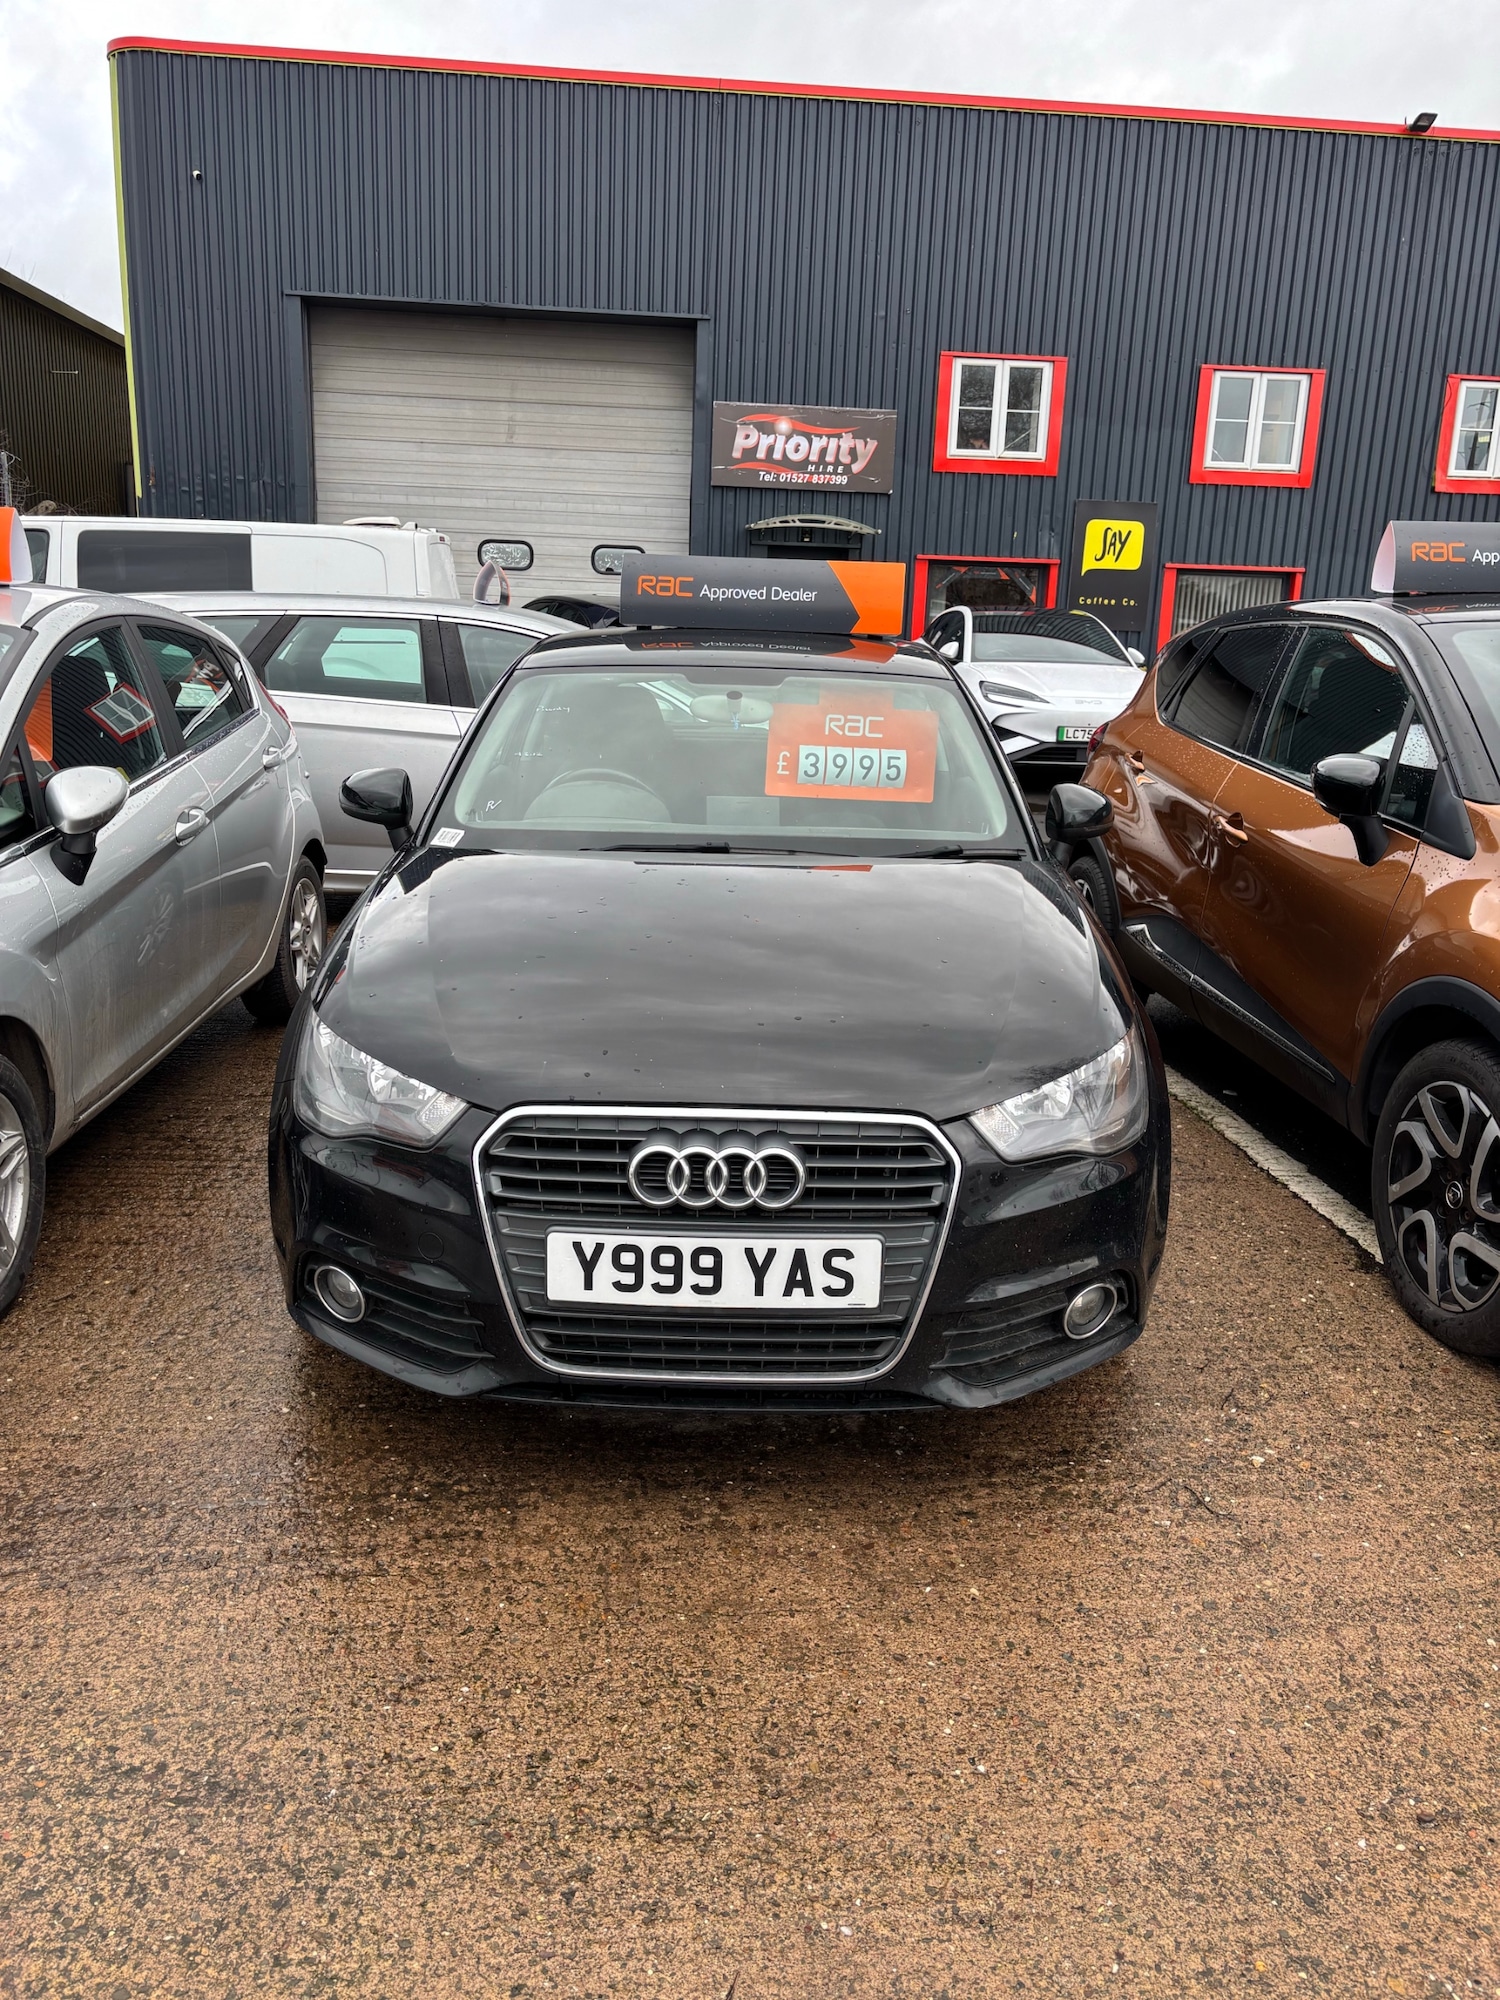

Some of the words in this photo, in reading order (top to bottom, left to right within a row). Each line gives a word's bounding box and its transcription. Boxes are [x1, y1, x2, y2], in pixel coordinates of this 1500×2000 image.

[732, 419, 878, 474] Priority
[759, 471, 777, 482] Tel:
[779, 473, 809, 484] 01527
[811, 475, 848, 485] 837399
[807, 465, 844, 473] HIRE
[1095, 527, 1132, 562] SAY
[699, 584, 766, 601] Approved
[771, 587, 818, 602] Dealer
[1079, 597, 1116, 605] Coffee
[1122, 598, 1138, 606] Co.
[572, 1241, 723, 1295] Y999
[744, 1247, 855, 1298] YAS
